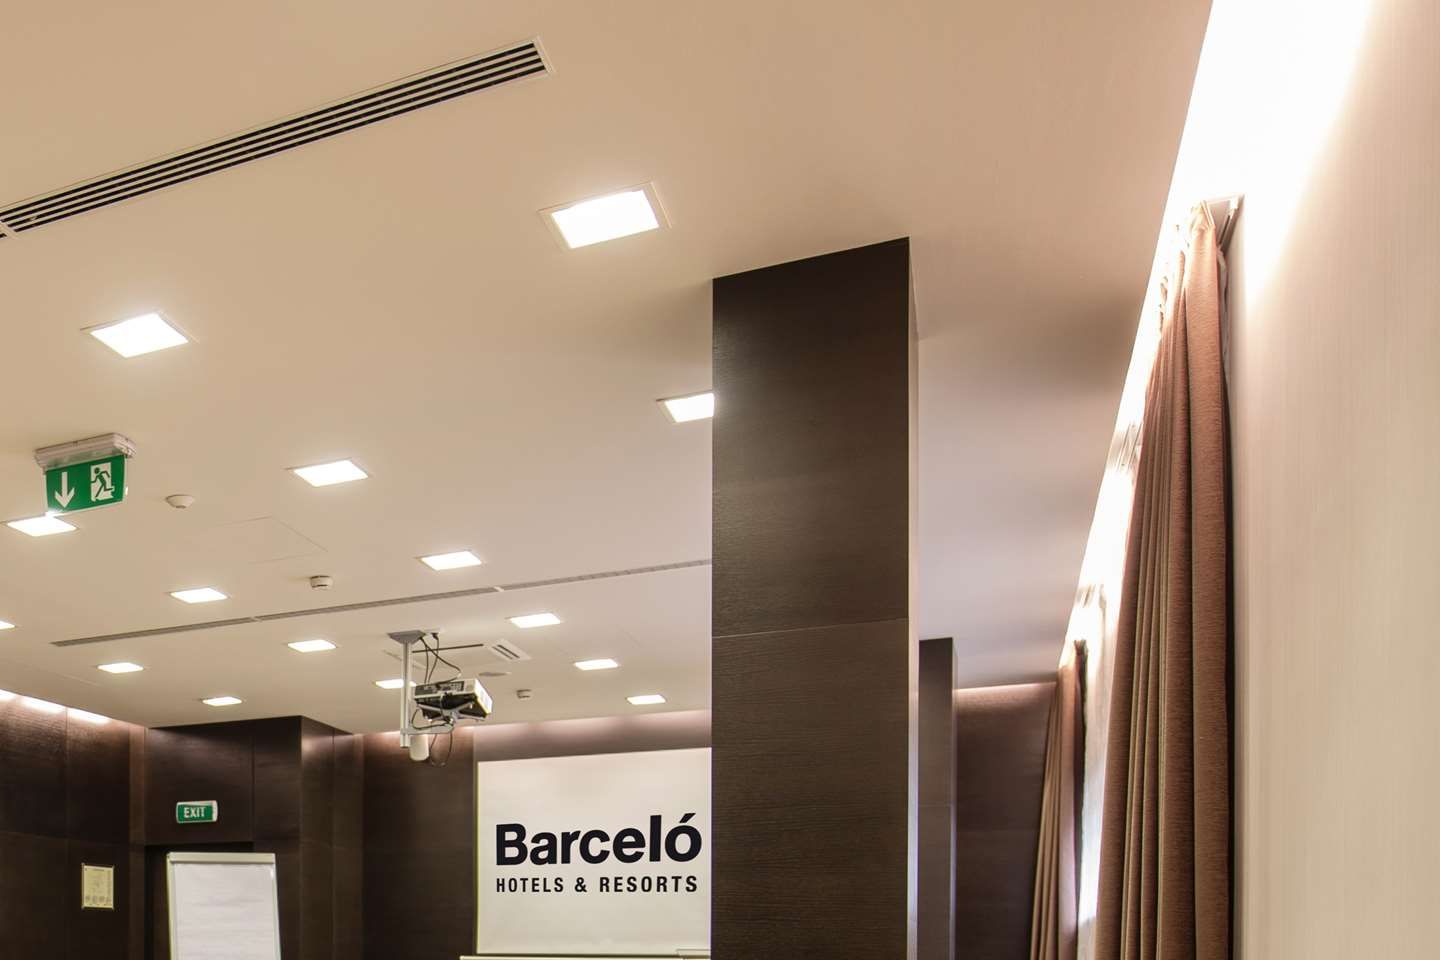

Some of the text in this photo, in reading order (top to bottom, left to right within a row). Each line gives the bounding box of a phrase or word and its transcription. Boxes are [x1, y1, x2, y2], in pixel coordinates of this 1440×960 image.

[183, 806, 206, 818] EXIT
[496, 812, 702, 866] Barceló
[496, 875, 698, 893] HOTELS & RESORTS
